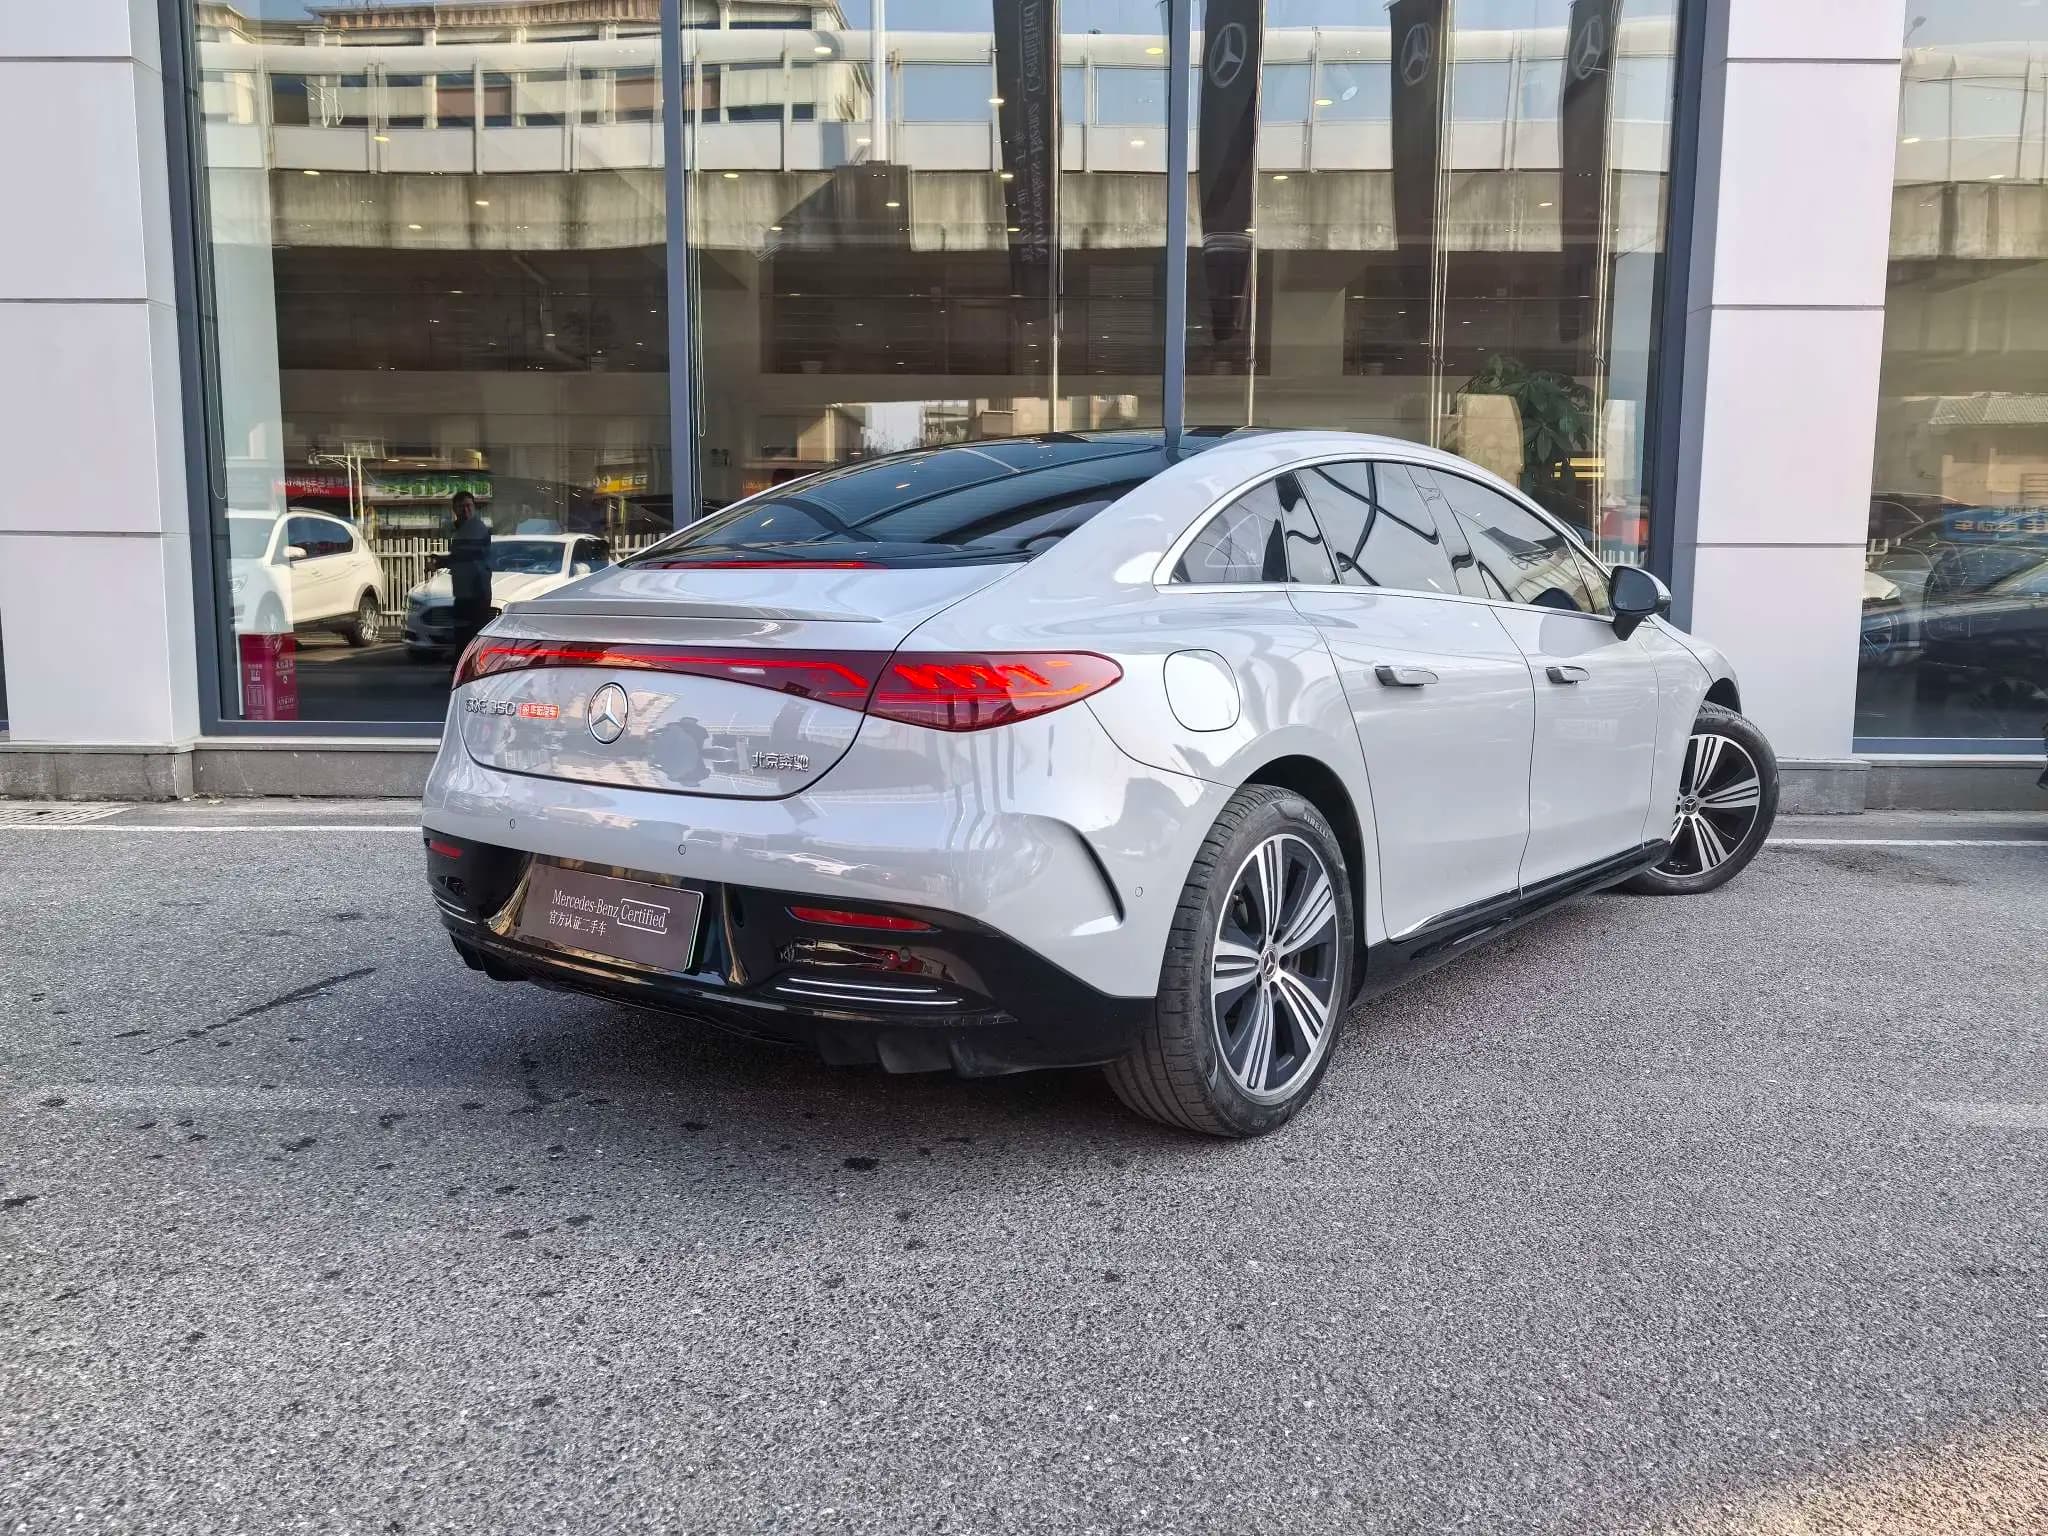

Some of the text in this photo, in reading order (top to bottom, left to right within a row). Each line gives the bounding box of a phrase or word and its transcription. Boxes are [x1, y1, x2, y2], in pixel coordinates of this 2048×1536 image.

[489, 699, 517, 716] 350
[552, 889, 666, 928] Mercedes-Benz Certified
[549, 909, 608, 937] 官方认证二手车
